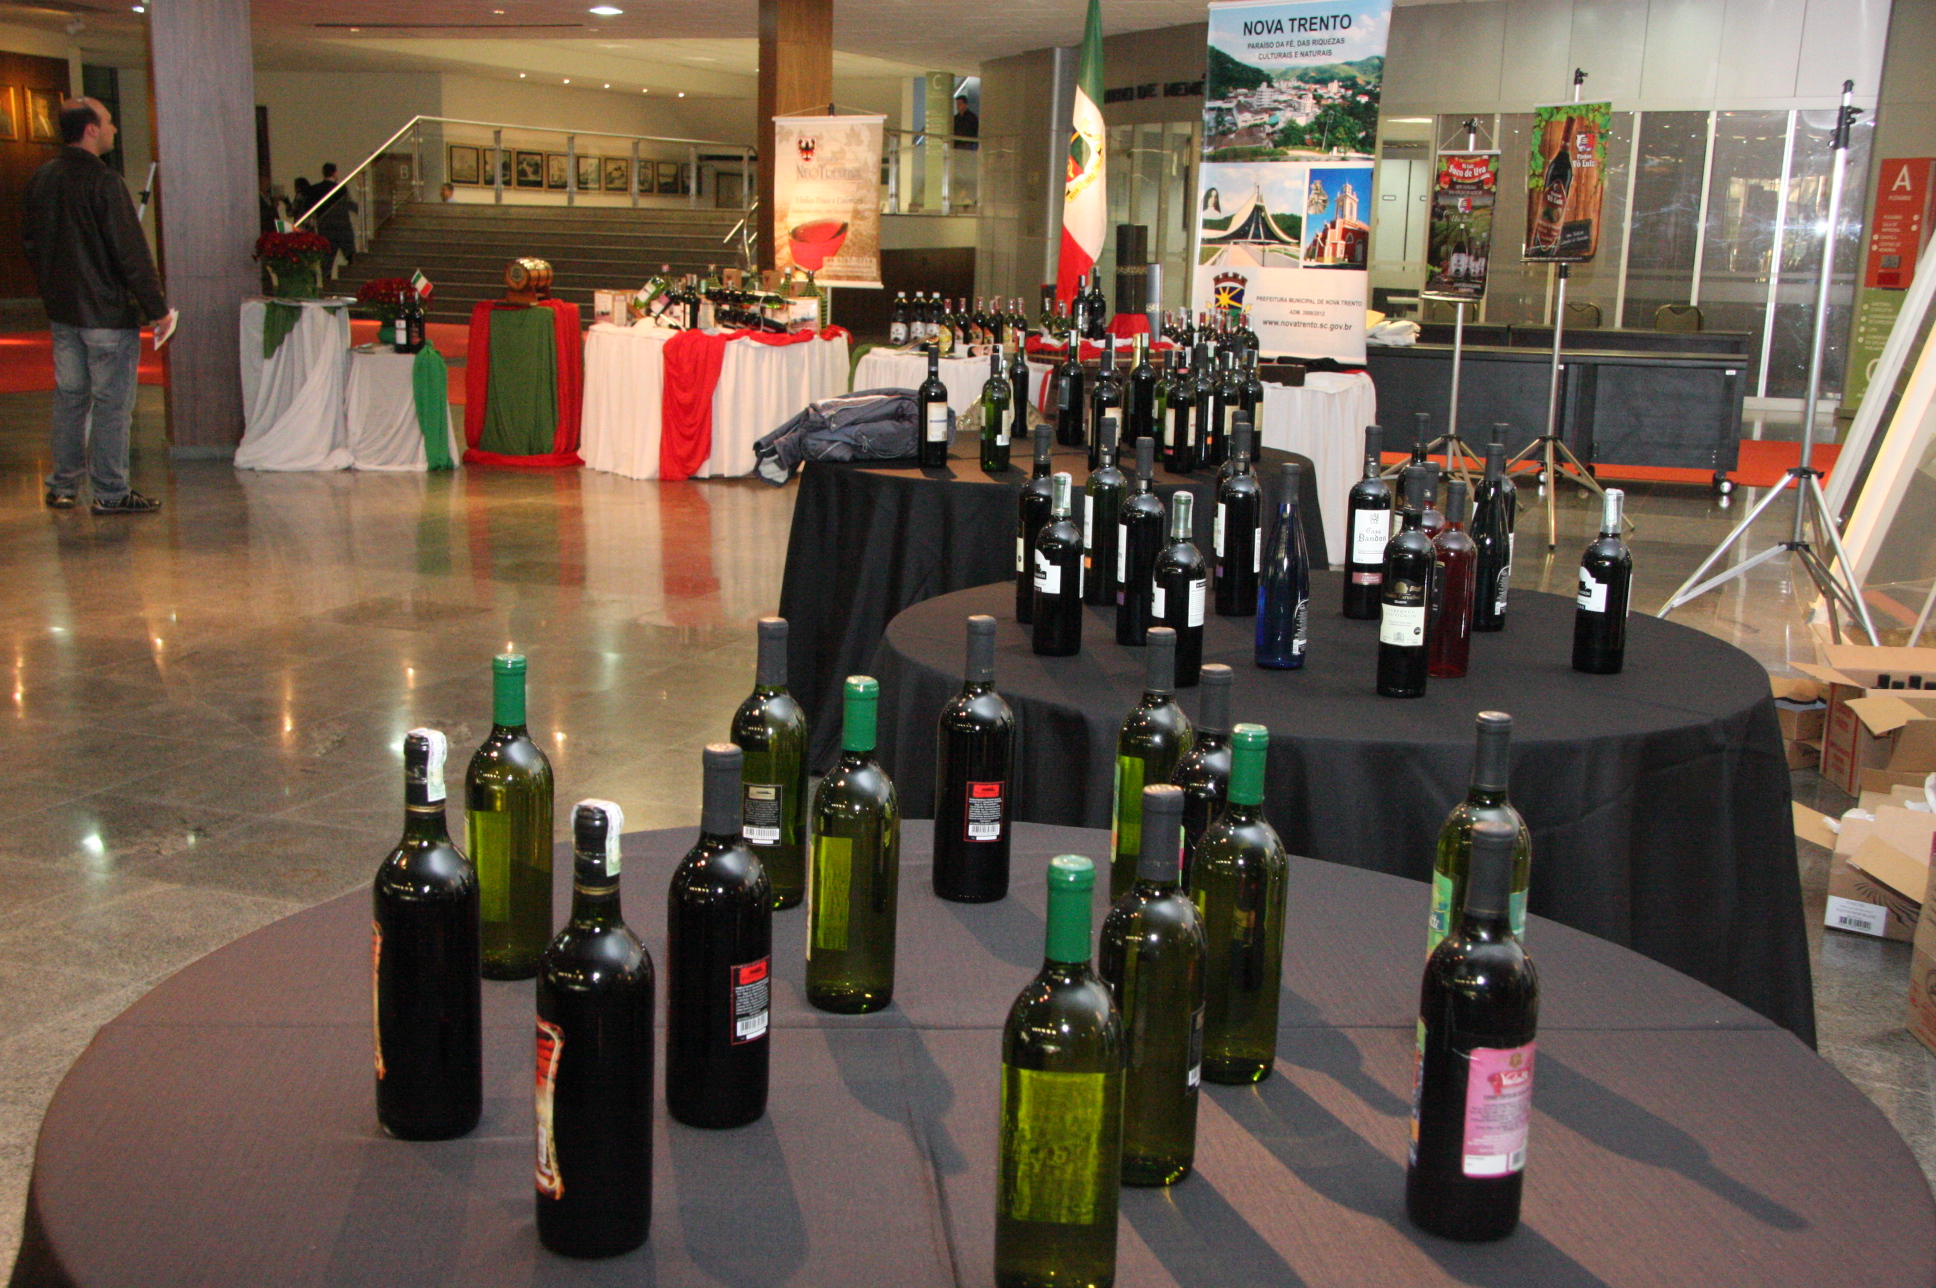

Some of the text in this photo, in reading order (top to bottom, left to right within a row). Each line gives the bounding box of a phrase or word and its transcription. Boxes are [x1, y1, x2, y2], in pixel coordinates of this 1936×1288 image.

[1243, 14, 1352, 36] NOVA TRENTO
[1247, 41, 1275, 50] PARAÍSO
[1275, 41, 1285, 49] DA
[1297, 39, 1311, 47] DAS
[1312, 37, 1345, 46] RIQUEZAS
[1258, 51, 1293, 60] CULTURAIS
[1299, 49, 1333, 58] NATURAIS
[1449, 164, 1487, 177] Suco de Uva
[1891, 164, 1911, 192] A
[1256, 295, 1288, 303] PREFEITURA
[1288, 297, 1316, 305] MUNICIPAL
[1341, 299, 1363, 307] TRENTO
[1262, 319, 1353, 332] www.novatrento.sc.gov.br
